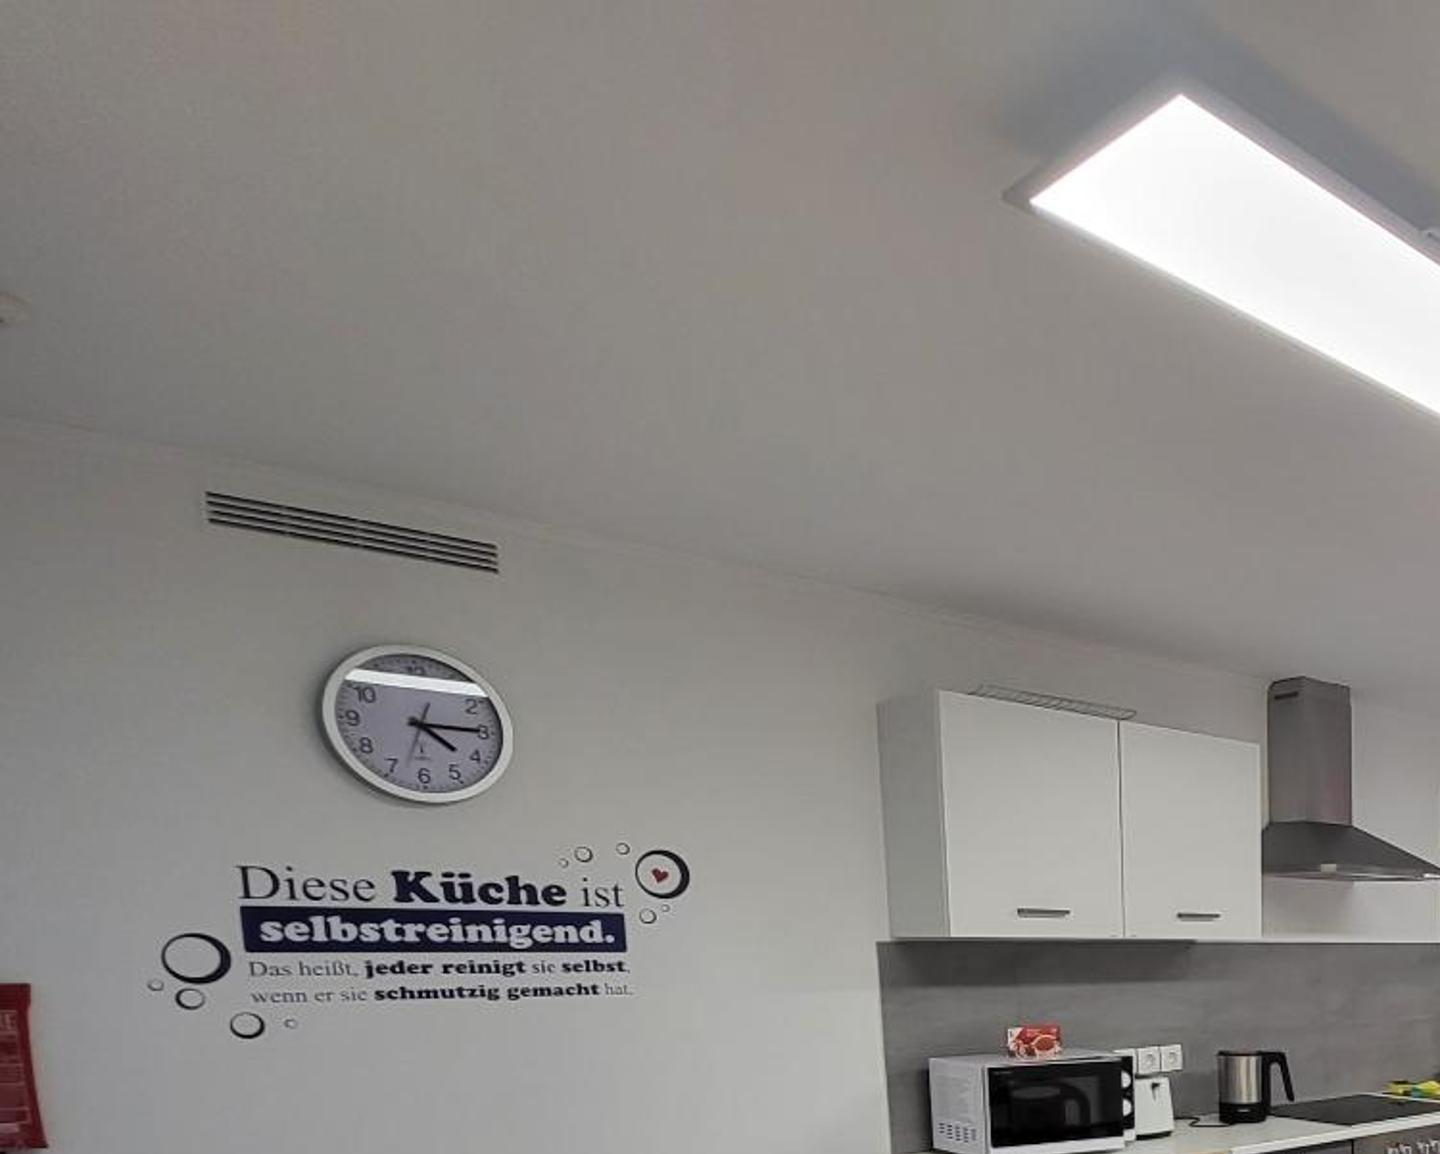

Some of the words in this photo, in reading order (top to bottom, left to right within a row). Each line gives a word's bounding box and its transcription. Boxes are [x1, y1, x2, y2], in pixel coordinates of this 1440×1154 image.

[355, 686, 376, 703] 10
[464, 698, 479, 714] 2
[345, 710, 361, 727] 9
[477, 723, 490, 740] 3
[360, 737, 374, 754] 8
[469, 748, 482, 764] 4
[384, 758, 399, 774] 7
[448, 763, 462, 781] 5
[417, 767, 432, 784] 6
[235, 865, 376, 902] Diese
[391, 870, 567, 906] Küche
[581, 877, 625, 908] ist
[260, 915, 616, 949] selbstreinigend.
[249, 961, 293, 978] Das
[299, 960, 360, 978] heißt,
[364, 960, 434, 979] jeder
[442, 960, 527, 977] reinigt
[532, 961, 557, 974] sie
[561, 960, 631, 975] selbst,
[251, 991, 308, 1003] wenn
[314, 991, 336, 1002] er
[340, 987, 368, 1002] sie
[374, 985, 500, 1001] schmutzig
[507, 983, 600, 1000] gemacht
[604, 983, 635, 997] hat.
